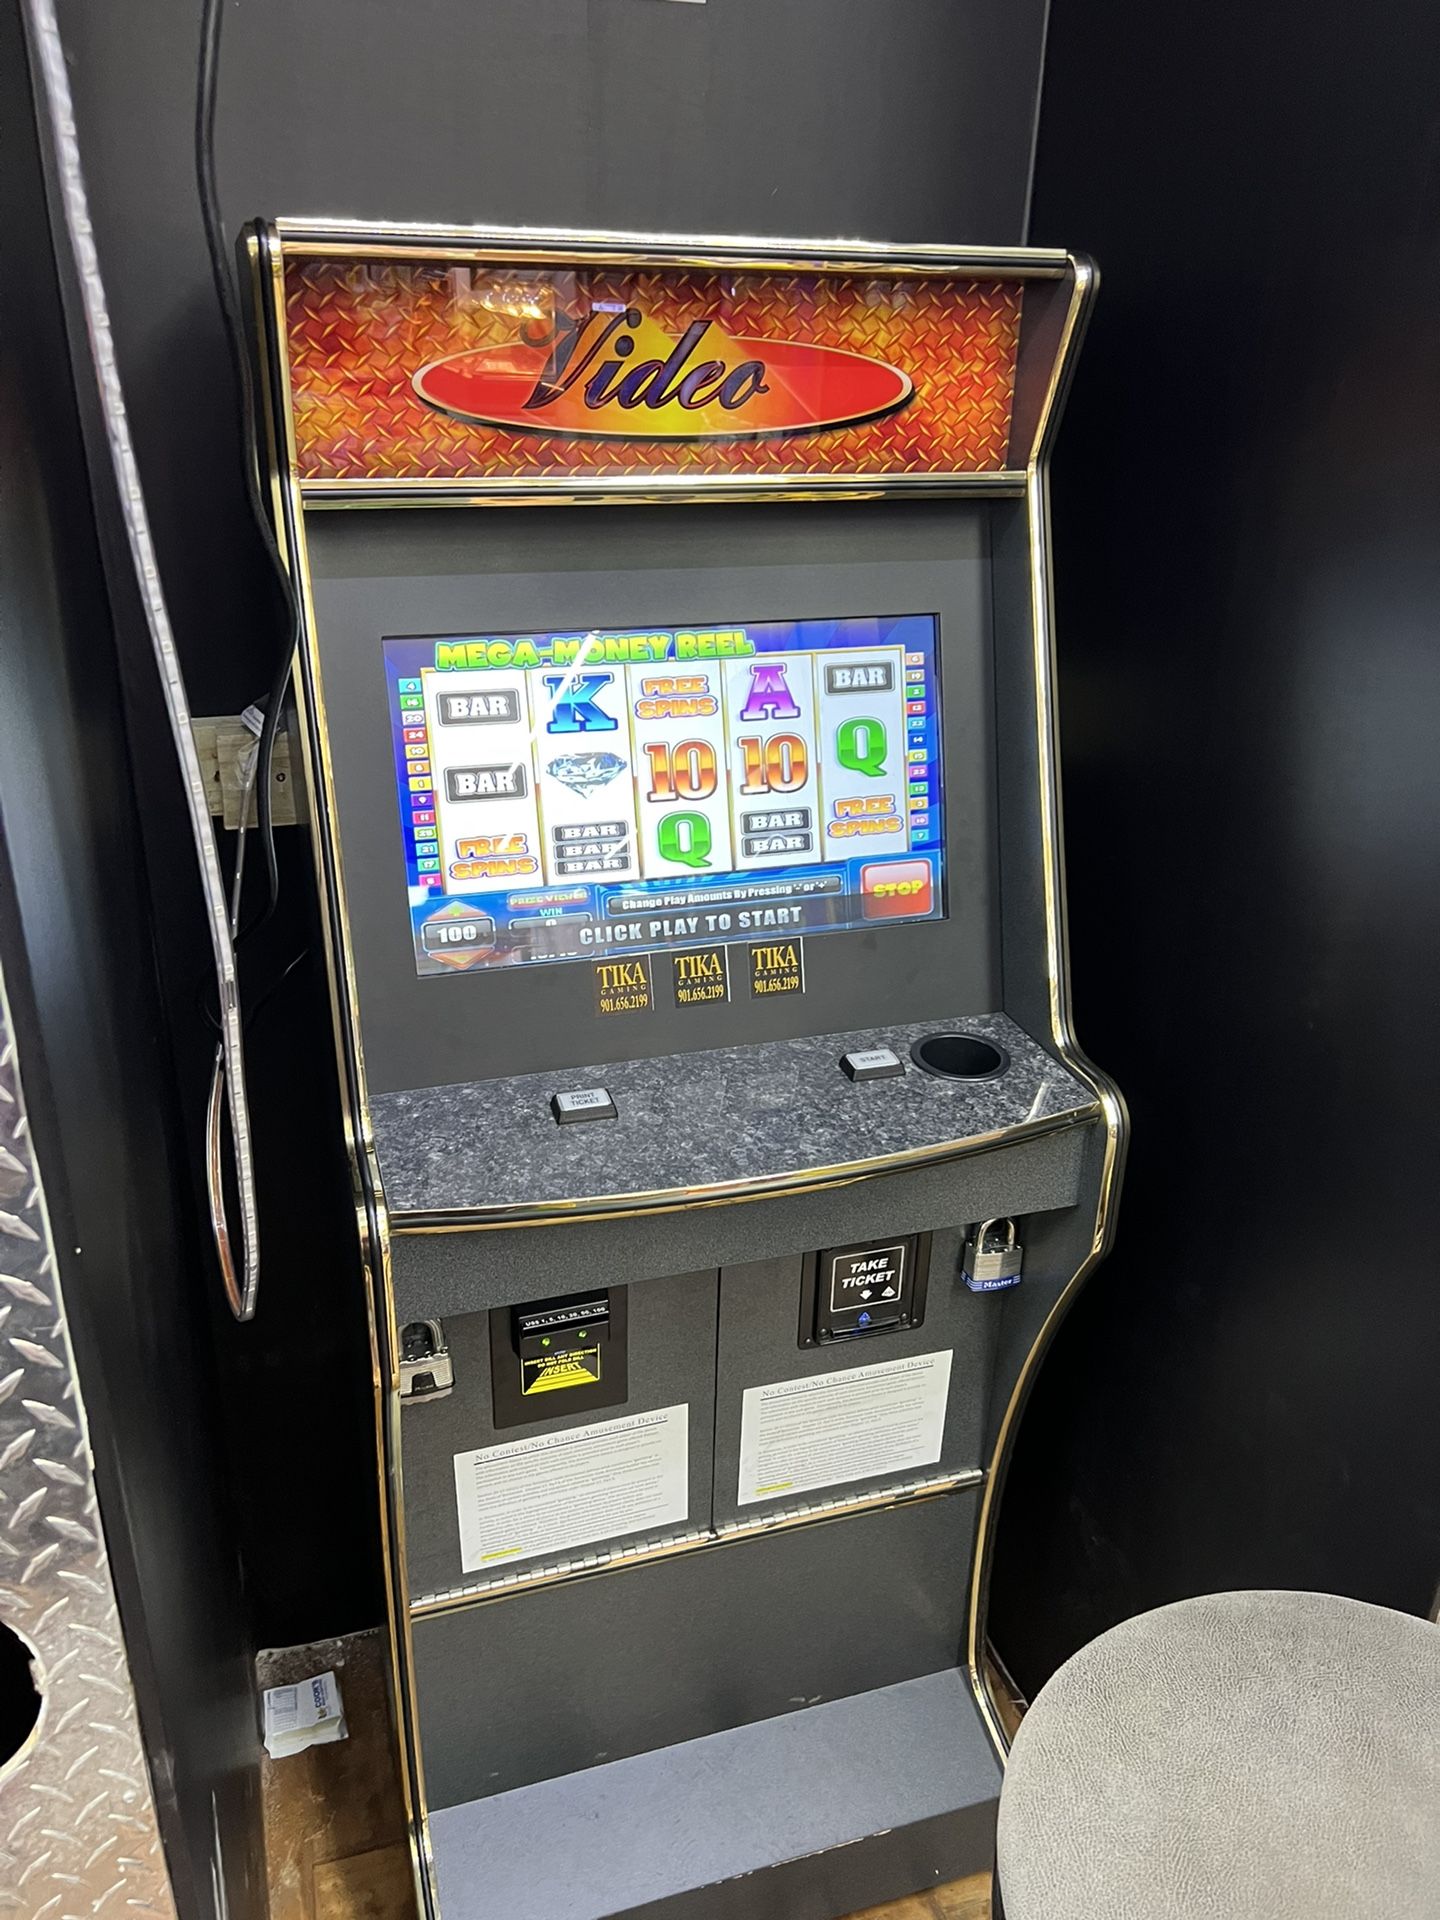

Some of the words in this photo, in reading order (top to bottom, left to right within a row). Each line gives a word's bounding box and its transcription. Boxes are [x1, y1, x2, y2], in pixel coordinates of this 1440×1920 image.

[519, 307, 769, 410] Video
[435, 633, 673, 671] MEGA-MONEY
[674, 629, 756, 659] REEL
[641, 675, 709, 697] FREE
[832, 666, 888, 689] BAR
[543, 672, 618, 734] K
[740, 662, 800, 721] A
[447, 695, 510, 719] BAR
[635, 696, 718, 720] SPINS
[836, 716, 888, 777] Q
[643, 738, 718, 802] 10
[737, 732, 809, 795] 10
[454, 771, 517, 796] BAR
[833, 794, 896, 819] FREE
[562, 823, 620, 840] BAR
[750, 810, 804, 831] BAR
[826, 815, 904, 839] SPINS
[657, 810, 713, 868] Q
[752, 835, 806, 855] BAR
[449, 855, 538, 879] SPINS
[565, 858, 622, 873] BAR
[622, 899, 662, 910] Change
[664, 895, 686, 906] Play
[687, 891, 732, 903] Amounts
[733, 889, 747, 899] By
[748, 885, 792, 897] Pressing
[872, 879, 924, 898] STOP
[540, 907, 563, 917] WIN
[437, 925, 477, 943] 100
[579, 922, 642, 945] CLICK
[649, 917, 699, 937] PLAY
[705, 913, 731, 931] TO
[738, 906, 802, 928] START
[674, 953, 723, 979] TIKA
[752, 945, 798, 970] TIKA
[596, 961, 647, 988] TIKA
[678, 974, 722, 986] GAMING
[754, 966, 798, 977] GAMING
[600, 984, 646, 996] GAMING
[678, 984, 724, 1003] 901.656.2199
[754, 975, 799, 993] 901.656.2199
[600, 993, 648, 1013] 901.656.2199
[570, 1092, 594, 1100] PRINT
[571, 1097, 599, 1106] TICKET
[850, 1257, 889, 1274] TAKE
[841, 1270, 896, 1288] TICKET
[983, 1278, 1013, 1289] Master
[540, 1362, 582, 1377] INSERT
[762, 1389, 775, 1397] No
[826, 1373, 856, 1385] Chance
[859, 1364, 905, 1378] Amusement
[907, 1358, 936, 1369] Device
[475, 1453, 489, 1462] No
[546, 1432, 580, 1446] Chance
[583, 1421, 635, 1438] Amusement
[638, 1413, 668, 1425] Device
